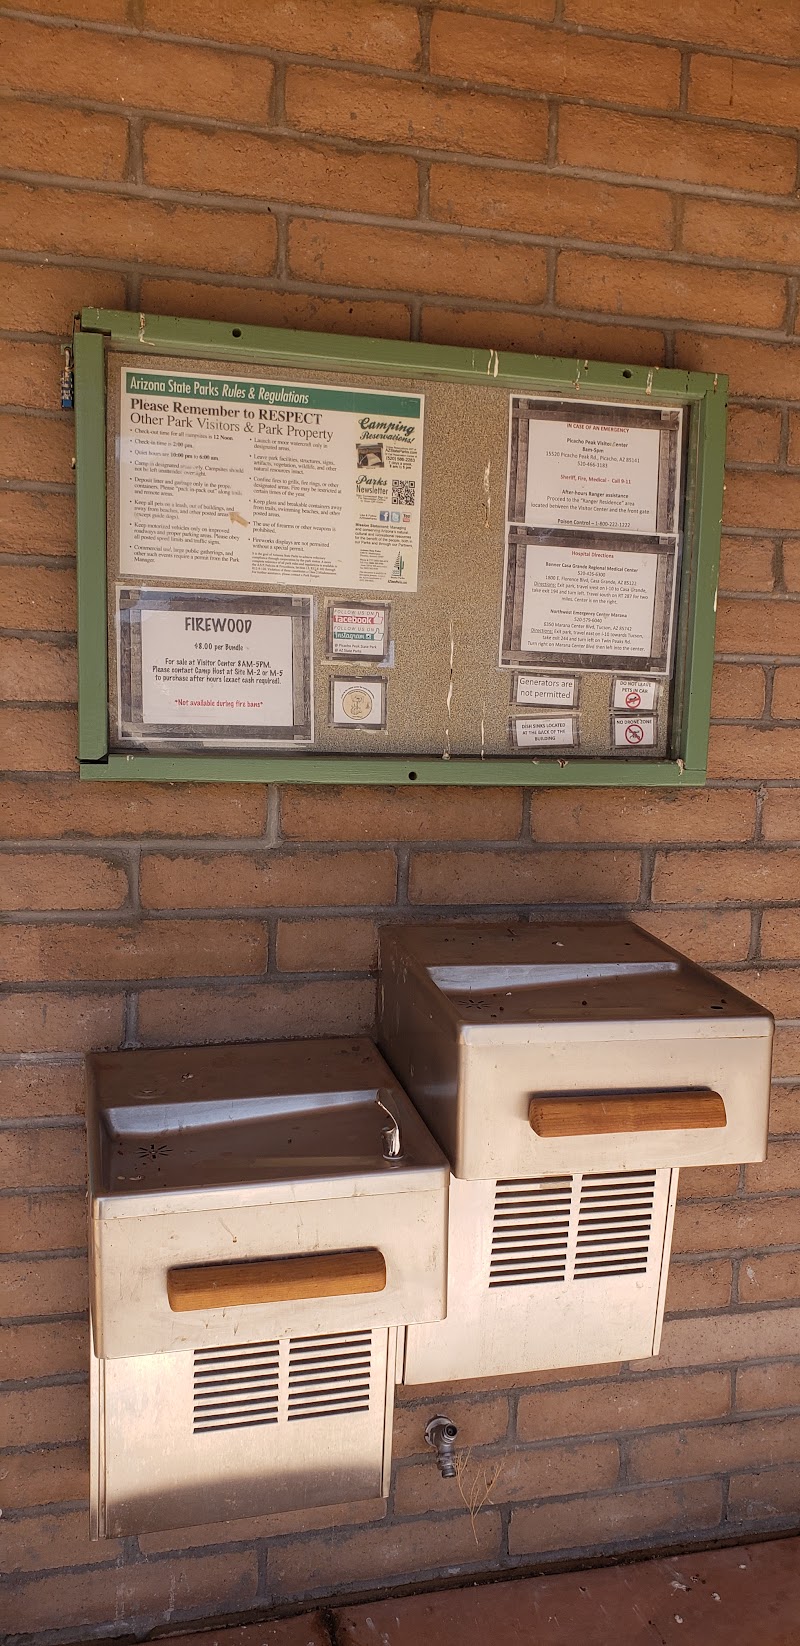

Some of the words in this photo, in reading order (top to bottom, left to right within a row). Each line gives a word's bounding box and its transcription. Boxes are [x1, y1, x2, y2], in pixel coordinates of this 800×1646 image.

[131, 377, 165, 391] Arizona
[168, 379, 191, 394] State
[194, 381, 218, 396] Parks
[222, 383, 245, 398] Rules
[248, 387, 255, 399] &
[258, 387, 309, 404] Regulations
[131, 398, 168, 412] Please
[174, 402, 239, 418] Remember
[244, 409, 254, 419] to
[259, 409, 322, 424] RESPECT
[130, 412, 163, 426] Other
[168, 415, 192, 428] Park
[197, 418, 239, 432] Visitors
[244, 422, 253, 433] &
[259, 423, 282, 435] Park
[288, 426, 334, 442] Property
[358, 417, 415, 436] Camping
[360, 431, 415, 444] Reservations!
[356, 475, 387, 486] Parks
[356, 485, 388, 495] Newsletter
[185, 617, 252, 633] FIREWOOD
[195, 667, 210, 675] Camp
[520, 678, 559, 686] Generators
[562, 679, 573, 687] are
